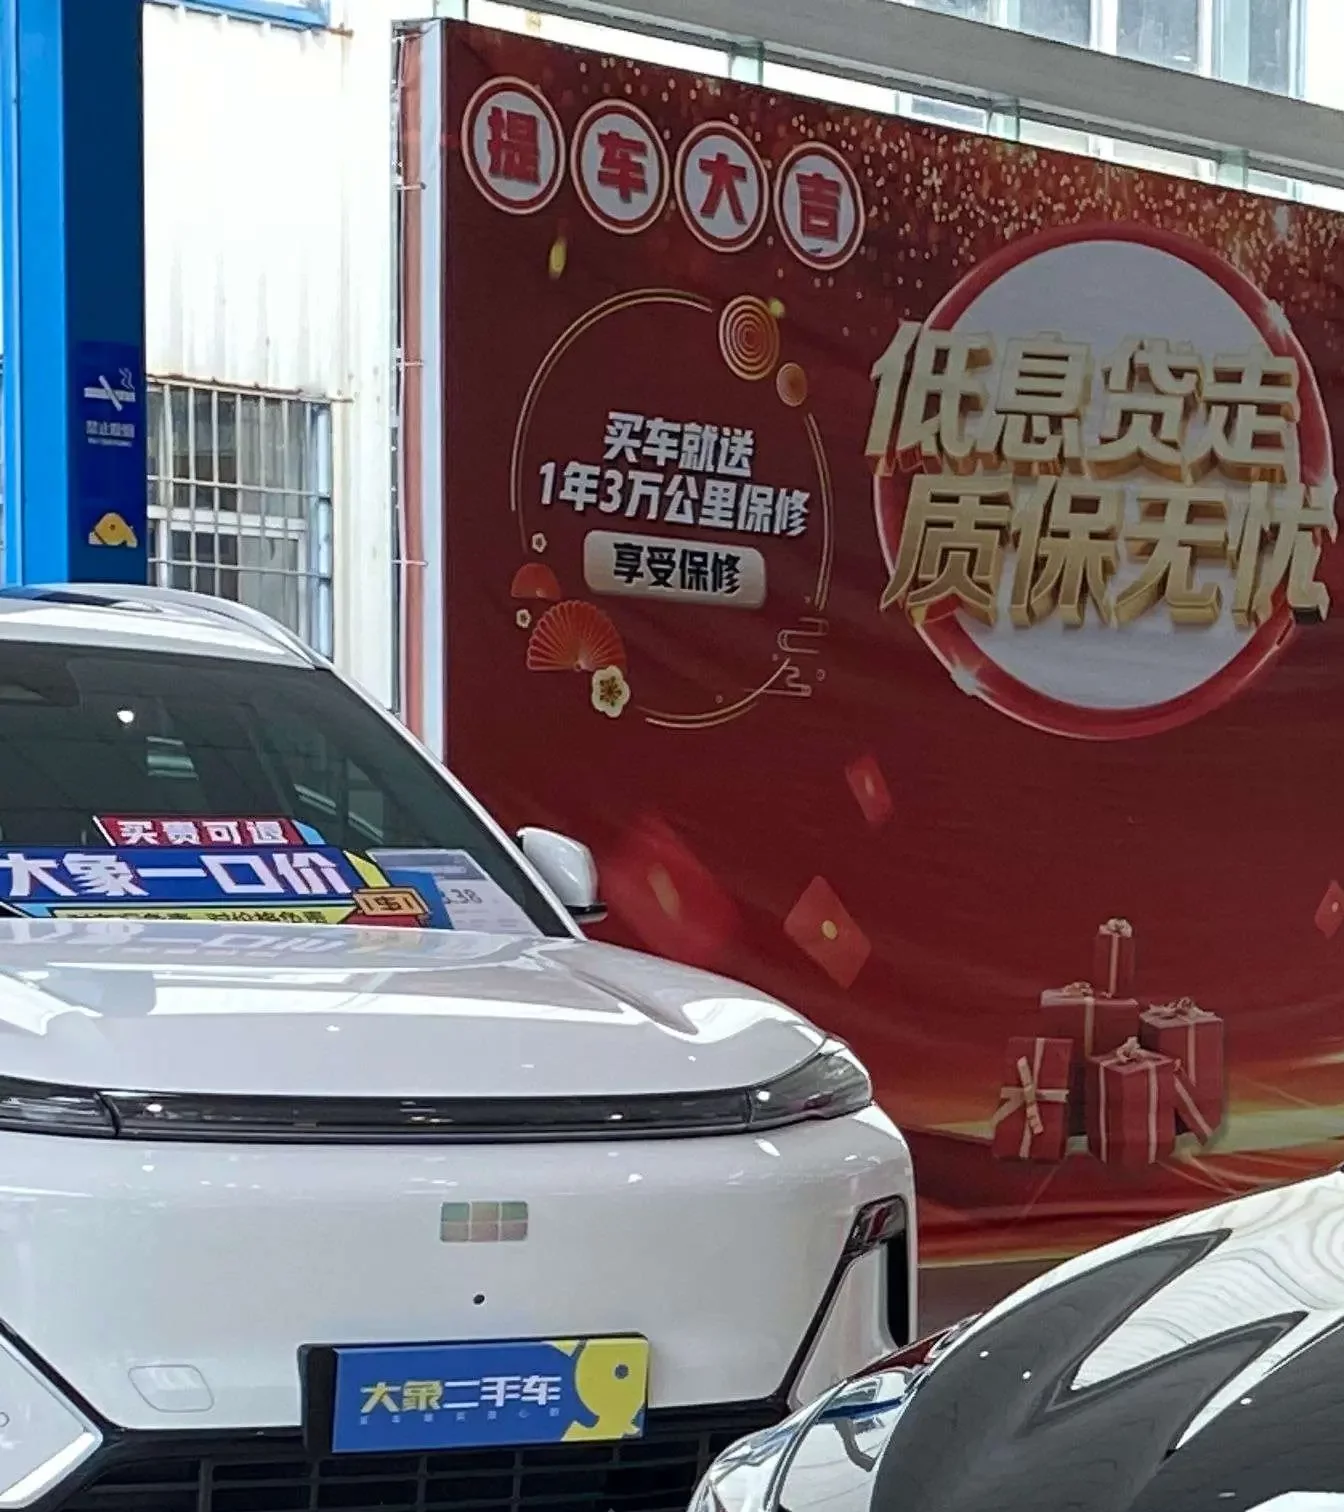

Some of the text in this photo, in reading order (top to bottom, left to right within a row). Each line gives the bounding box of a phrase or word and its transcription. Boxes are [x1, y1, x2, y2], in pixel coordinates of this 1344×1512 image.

[488, 106, 842, 243] 提车大吉
[866, 318, 1300, 483] 低息贷走
[603, 411, 755, 479] 买车就送
[538, 461, 811, 537] 1年3万公里保修
[612, 541, 743, 595] 享受保修
[880, 472, 1338, 629] 质保无忧
[117, 819, 288, 846] 买贵可退
[0, 852, 353, 898] 大象一口价
[360, 1375, 562, 1413] 大象二手车
